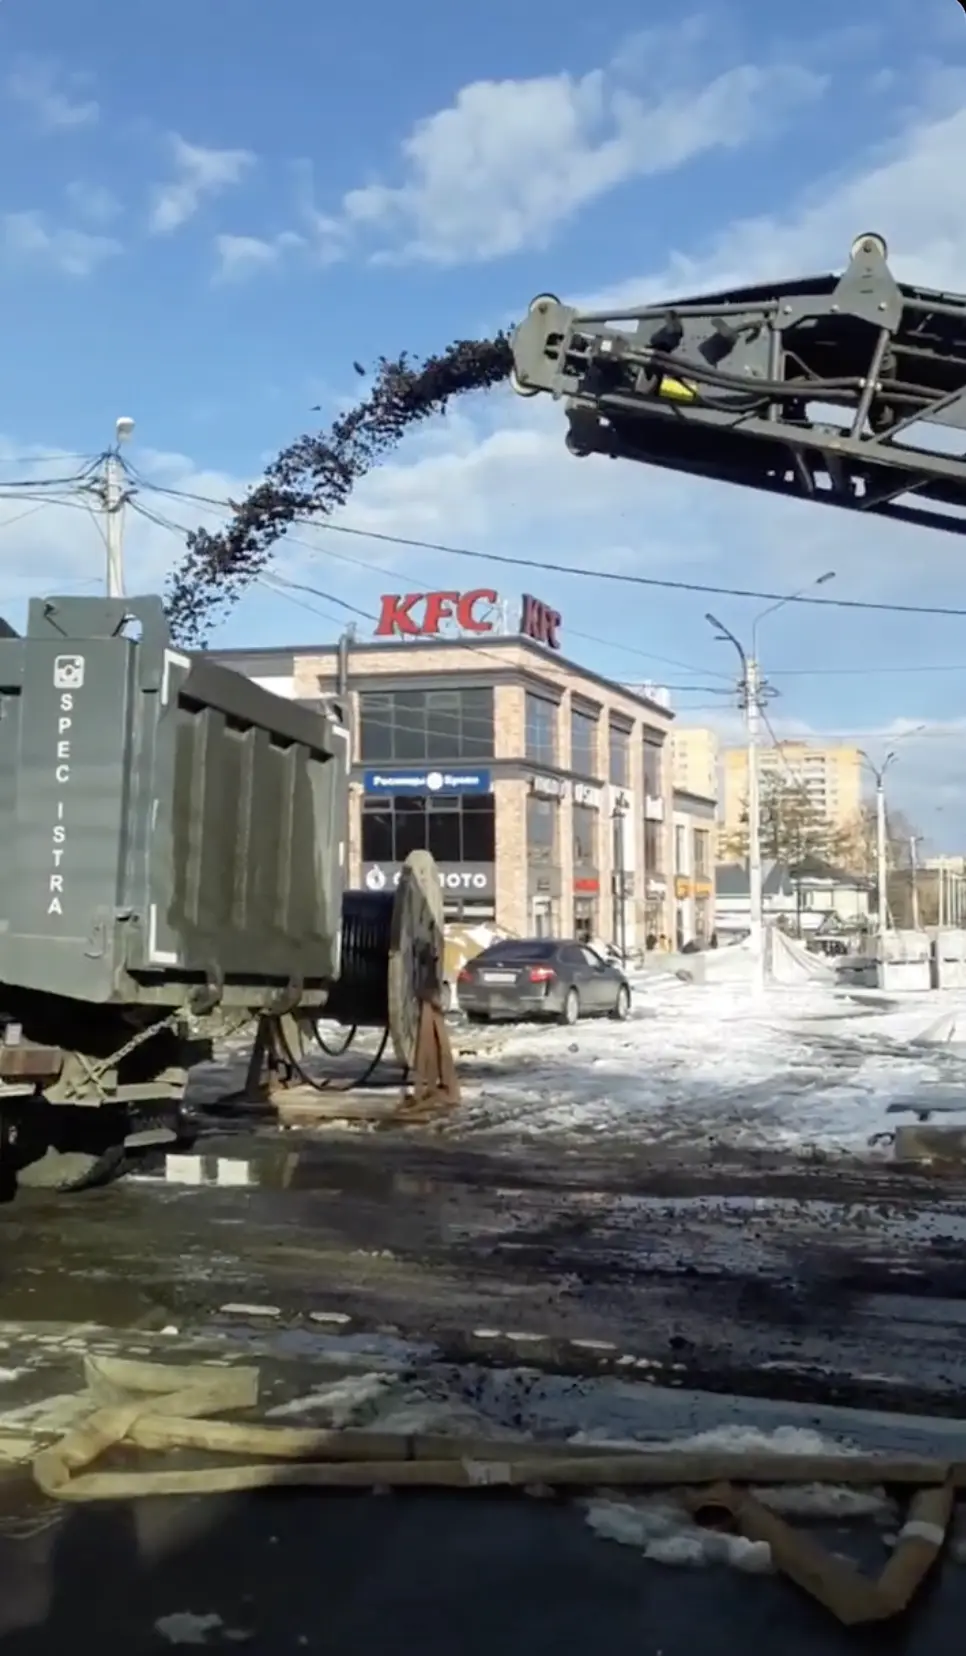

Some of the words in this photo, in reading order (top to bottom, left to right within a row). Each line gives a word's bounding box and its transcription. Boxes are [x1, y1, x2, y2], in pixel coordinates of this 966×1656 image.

[374, 588, 497, 635] KFC
[519, 593, 561, 649] KFC
[55, 693, 73, 783] SPEC
[48, 801, 66, 915] ISTRA
